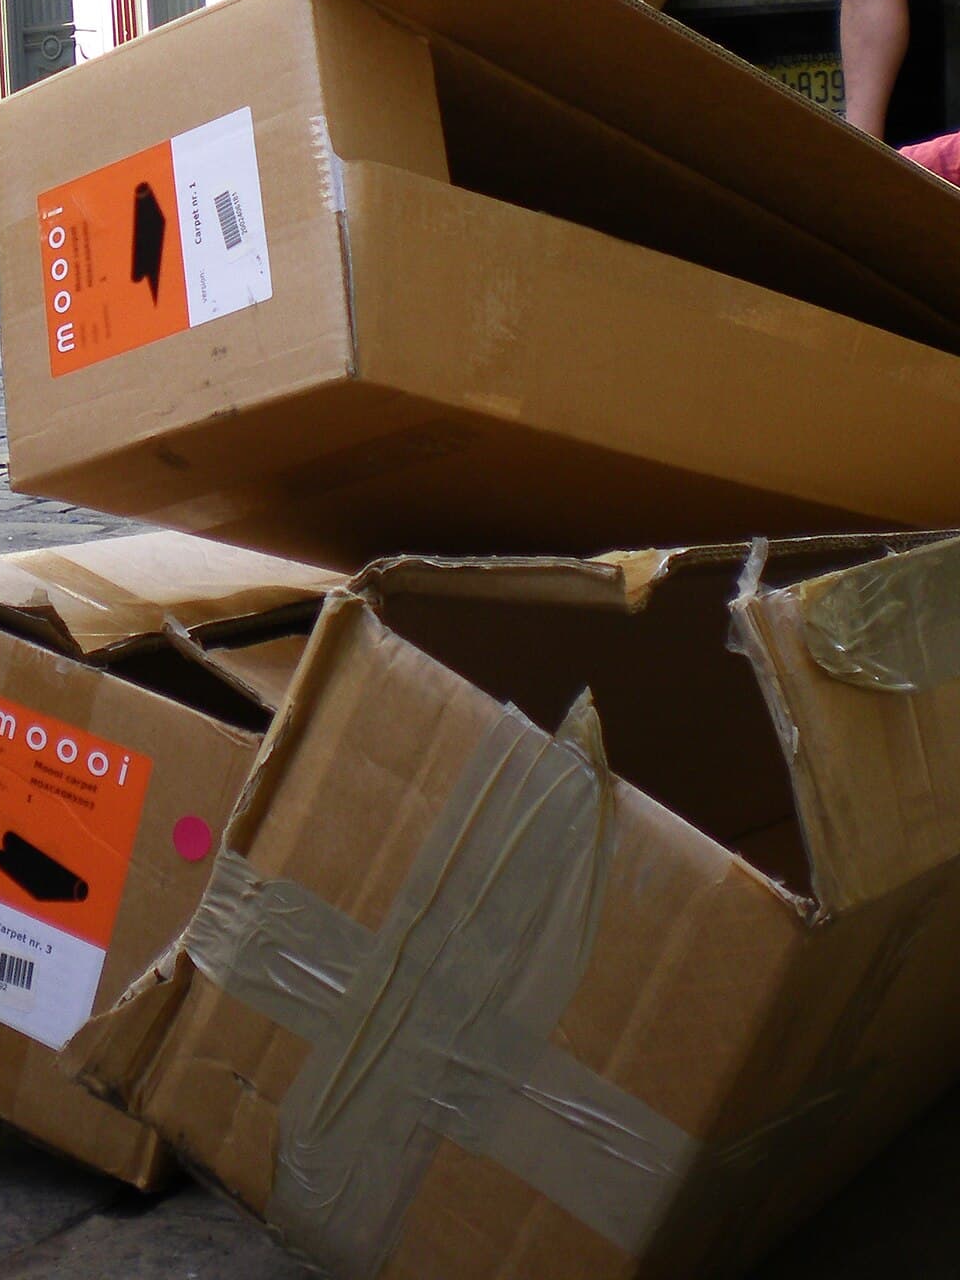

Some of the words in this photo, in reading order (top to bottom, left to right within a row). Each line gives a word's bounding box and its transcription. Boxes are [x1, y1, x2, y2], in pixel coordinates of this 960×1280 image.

[192, 210, 202, 245] Carpet
[42, 207, 75, 353] moooi
[28, 938, 43, 951] nr.
[45, 944, 53, 955] 3
